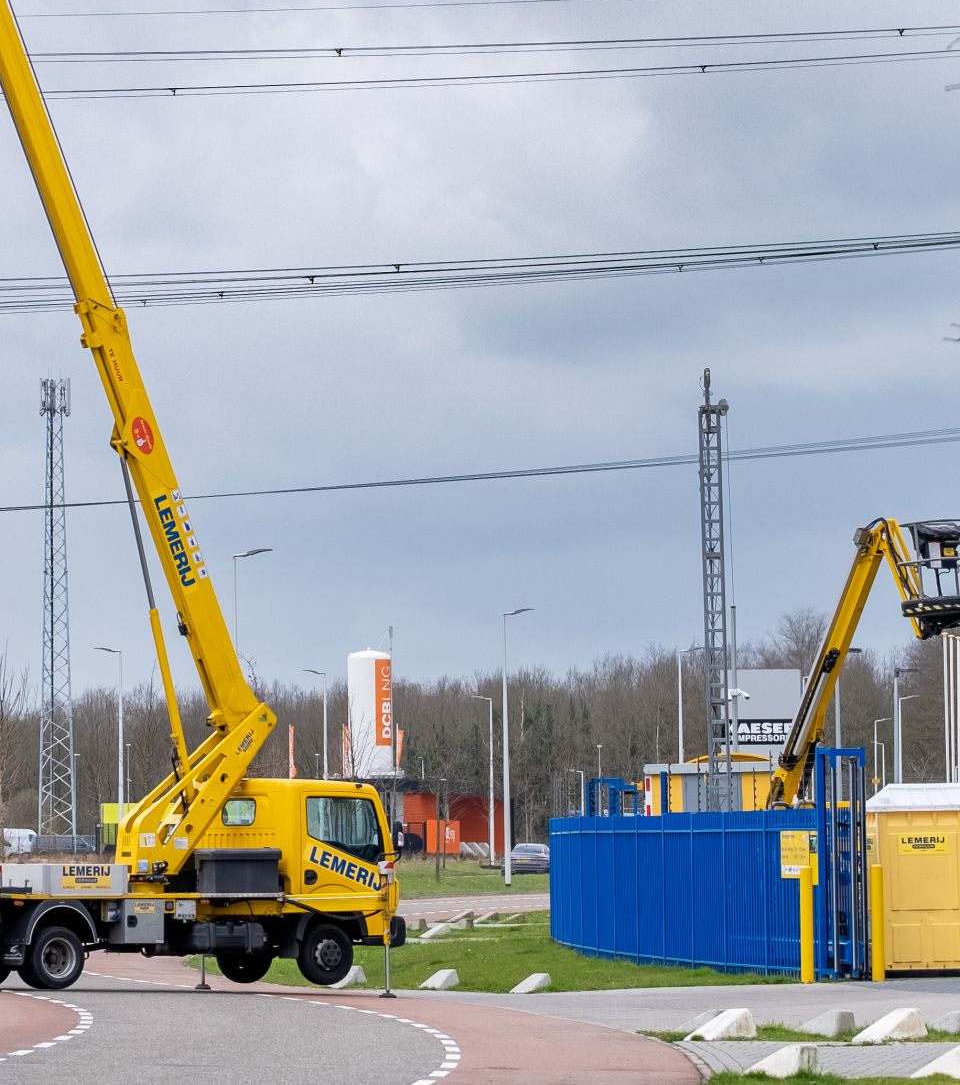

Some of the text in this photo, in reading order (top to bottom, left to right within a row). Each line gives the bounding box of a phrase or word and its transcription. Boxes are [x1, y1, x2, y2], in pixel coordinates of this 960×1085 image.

[108, 348, 115, 358] TE
[153, 494, 196, 587] LEMERIJ
[901, 836, 945, 844] LEMERIJ
[62, 866, 111, 877] LEMERIJ
[309, 846, 382, 892] LEMERIJ
